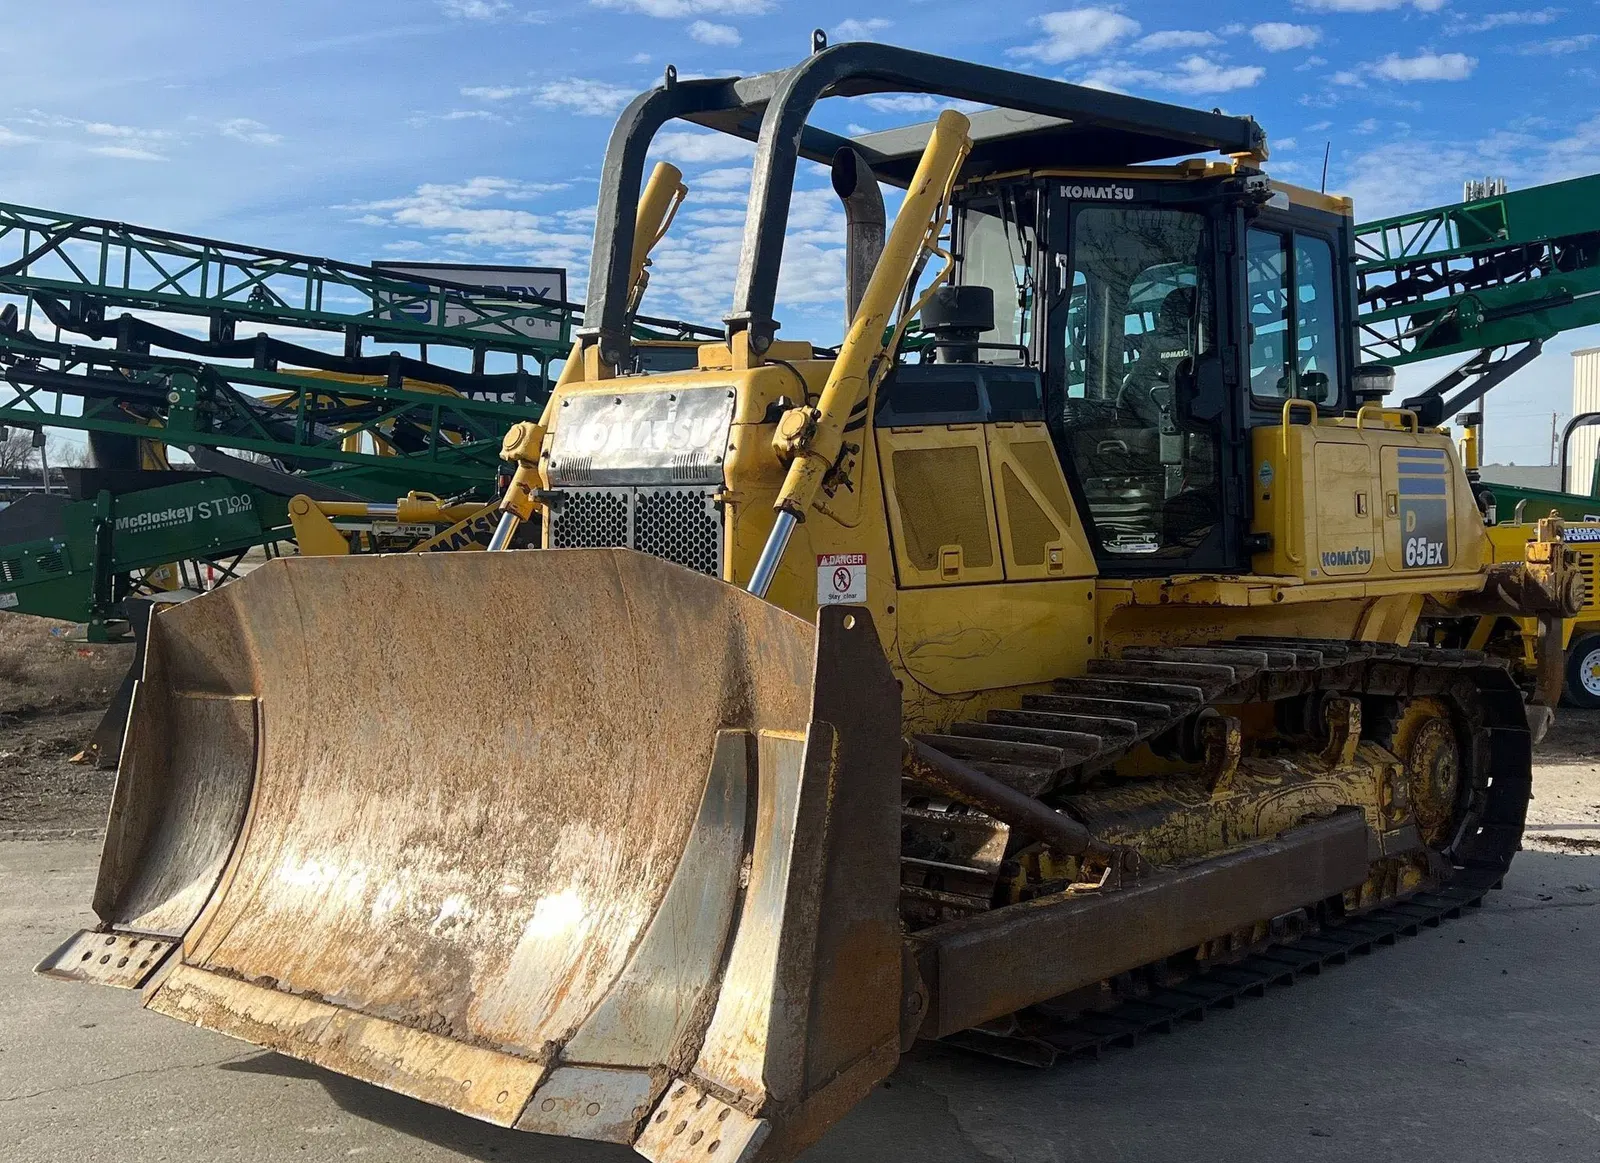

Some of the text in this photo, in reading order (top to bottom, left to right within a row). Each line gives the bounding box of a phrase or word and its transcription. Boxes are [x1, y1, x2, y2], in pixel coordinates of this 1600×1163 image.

[1060, 184, 1134, 200] KOMATSU
[1160, 349, 1190, 359] KOMATS
[565, 412, 720, 451] KOMATSU
[115, 506, 194, 530] McCloskey
[1405, 510, 1417, 533] D
[829, 554, 864, 565] DANGER
[1321, 546, 1371, 567] KOMATSU
[1405, 537, 1443, 567] 65EX
[827, 593, 841, 601] Stay
